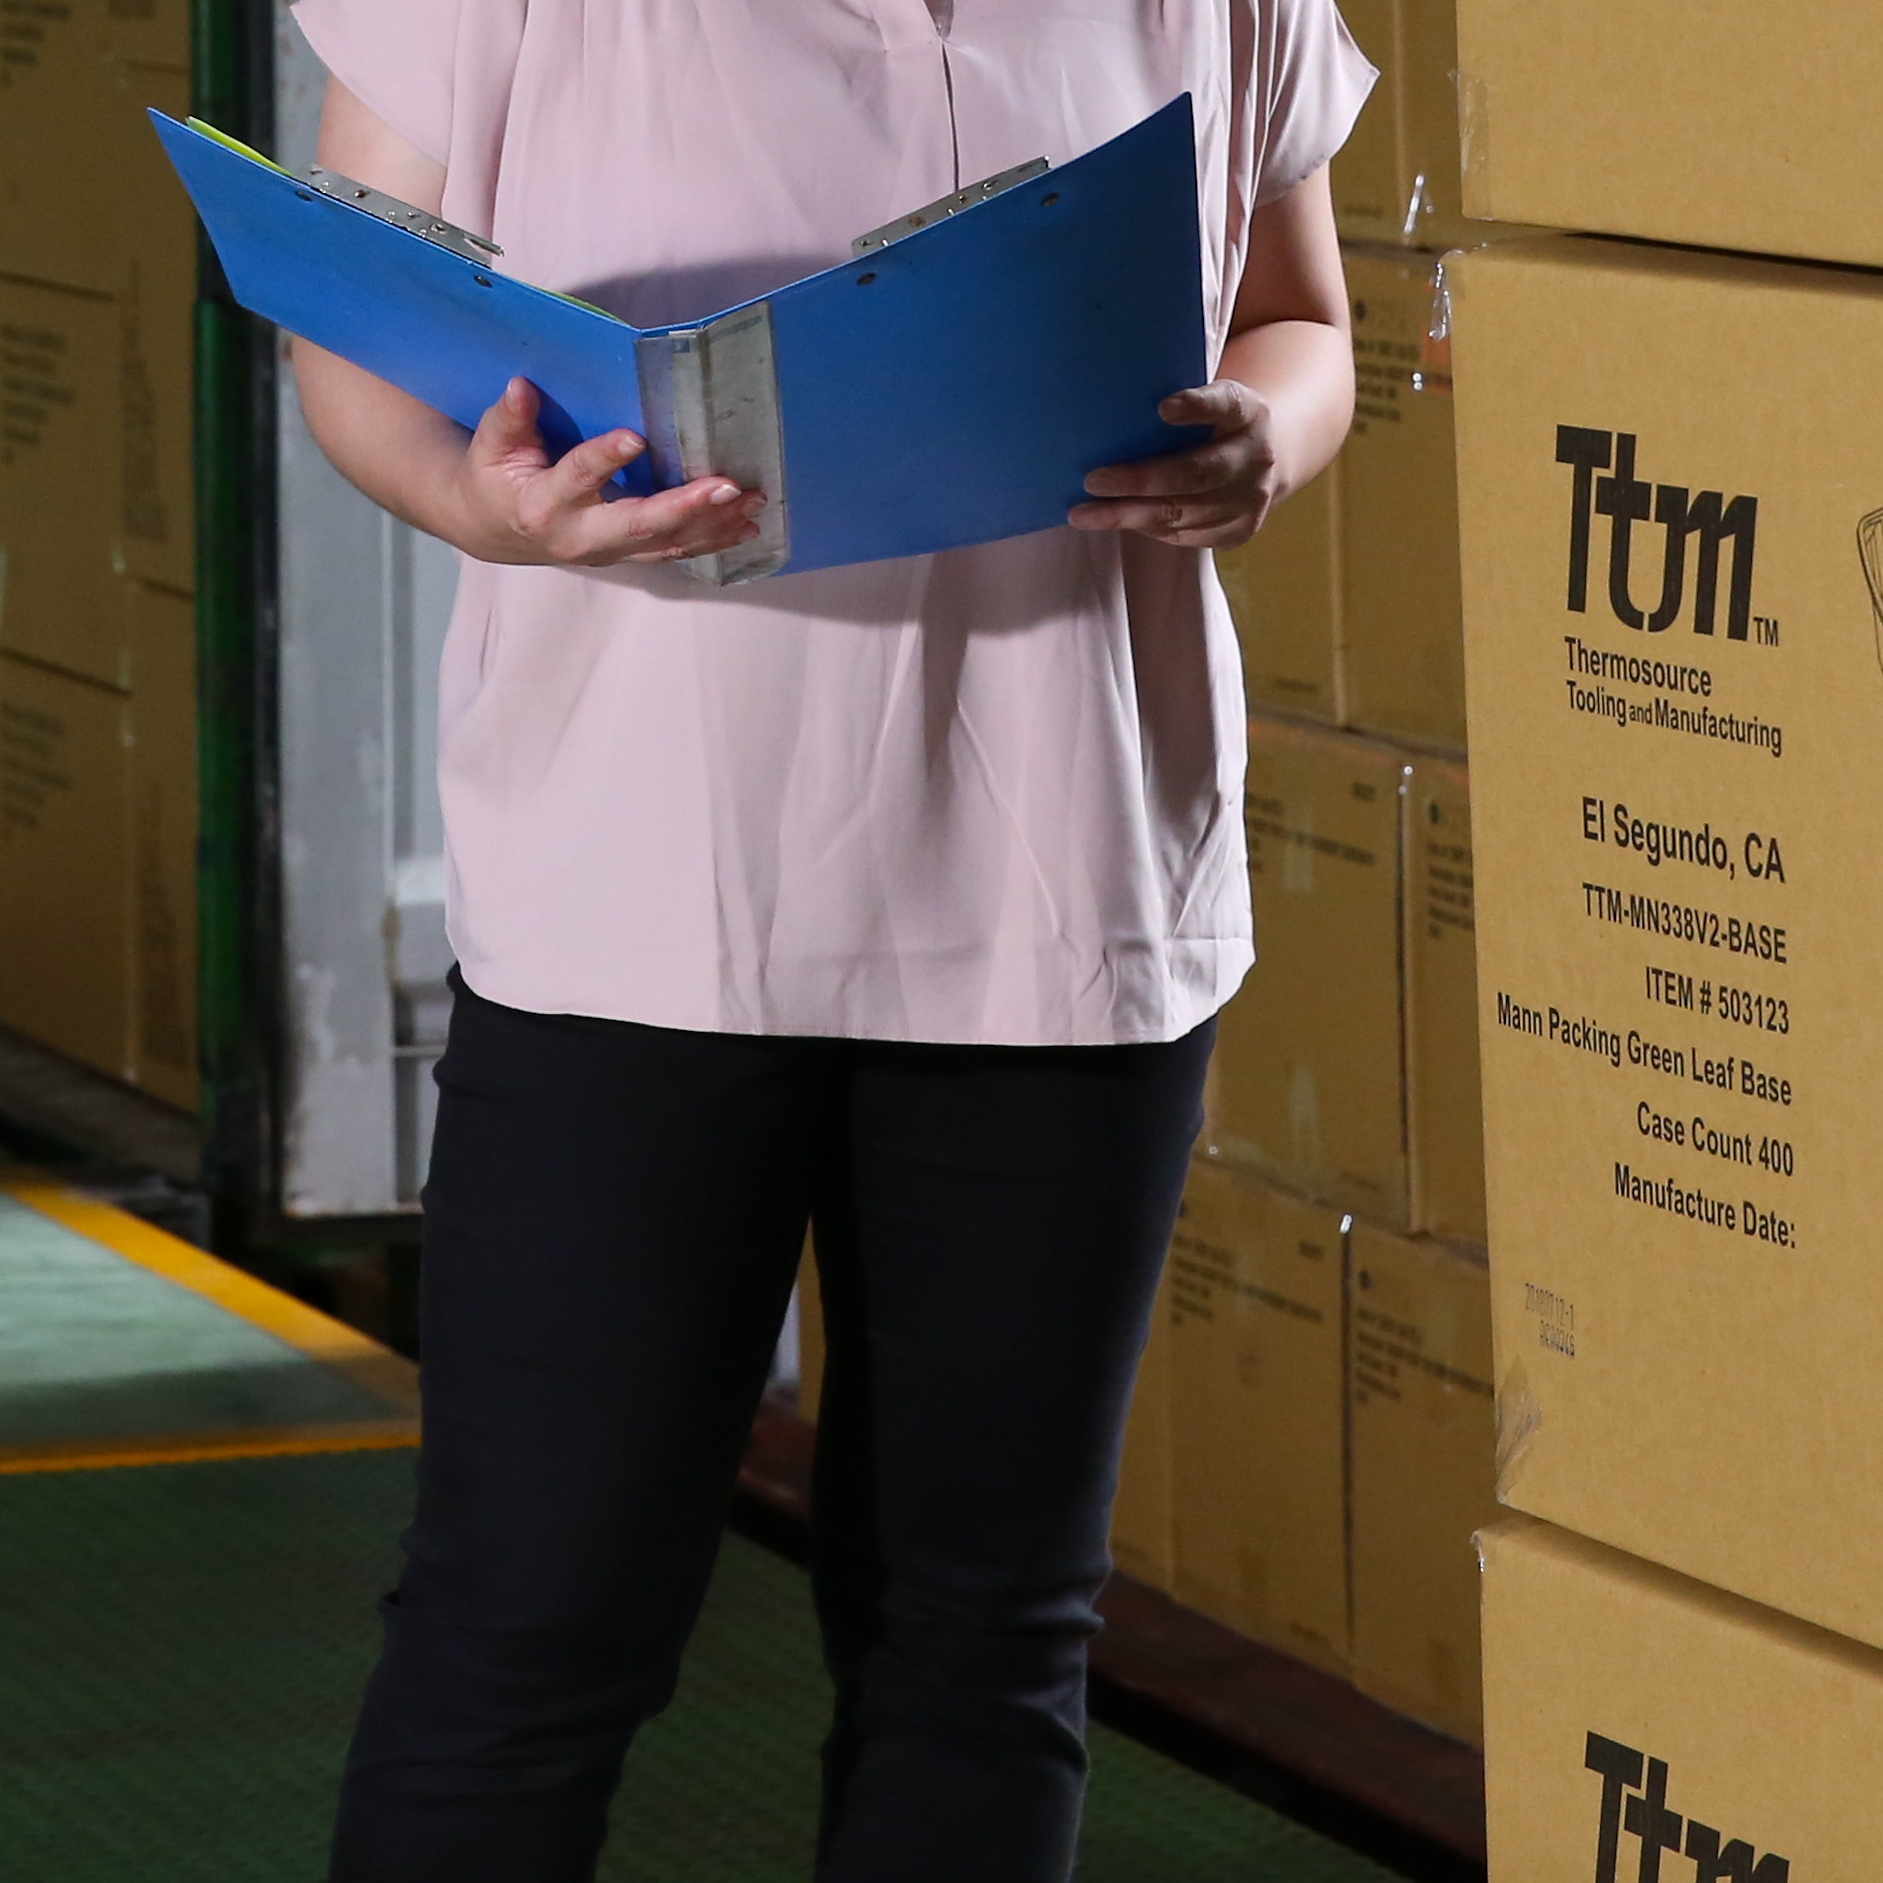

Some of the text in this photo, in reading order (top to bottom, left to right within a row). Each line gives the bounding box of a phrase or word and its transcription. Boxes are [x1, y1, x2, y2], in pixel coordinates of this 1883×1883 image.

[1564, 635, 1712, 697] Thermosource
[1566, 679, 1782, 758] Tooling and Manufacturing
[1582, 796, 1786, 884] El Segundo, CA
[1582, 882, 1787, 964] TTM-MN338V2-BASE
[1646, 966, 1789, 1035] ITEM # 503123
[1497, 991, 1792, 1106] Mann Packing Green Leaf Base
[1637, 1101, 1794, 1177] Case Count 400
[1614, 1161, 1795, 1249] Manufacture Date:
